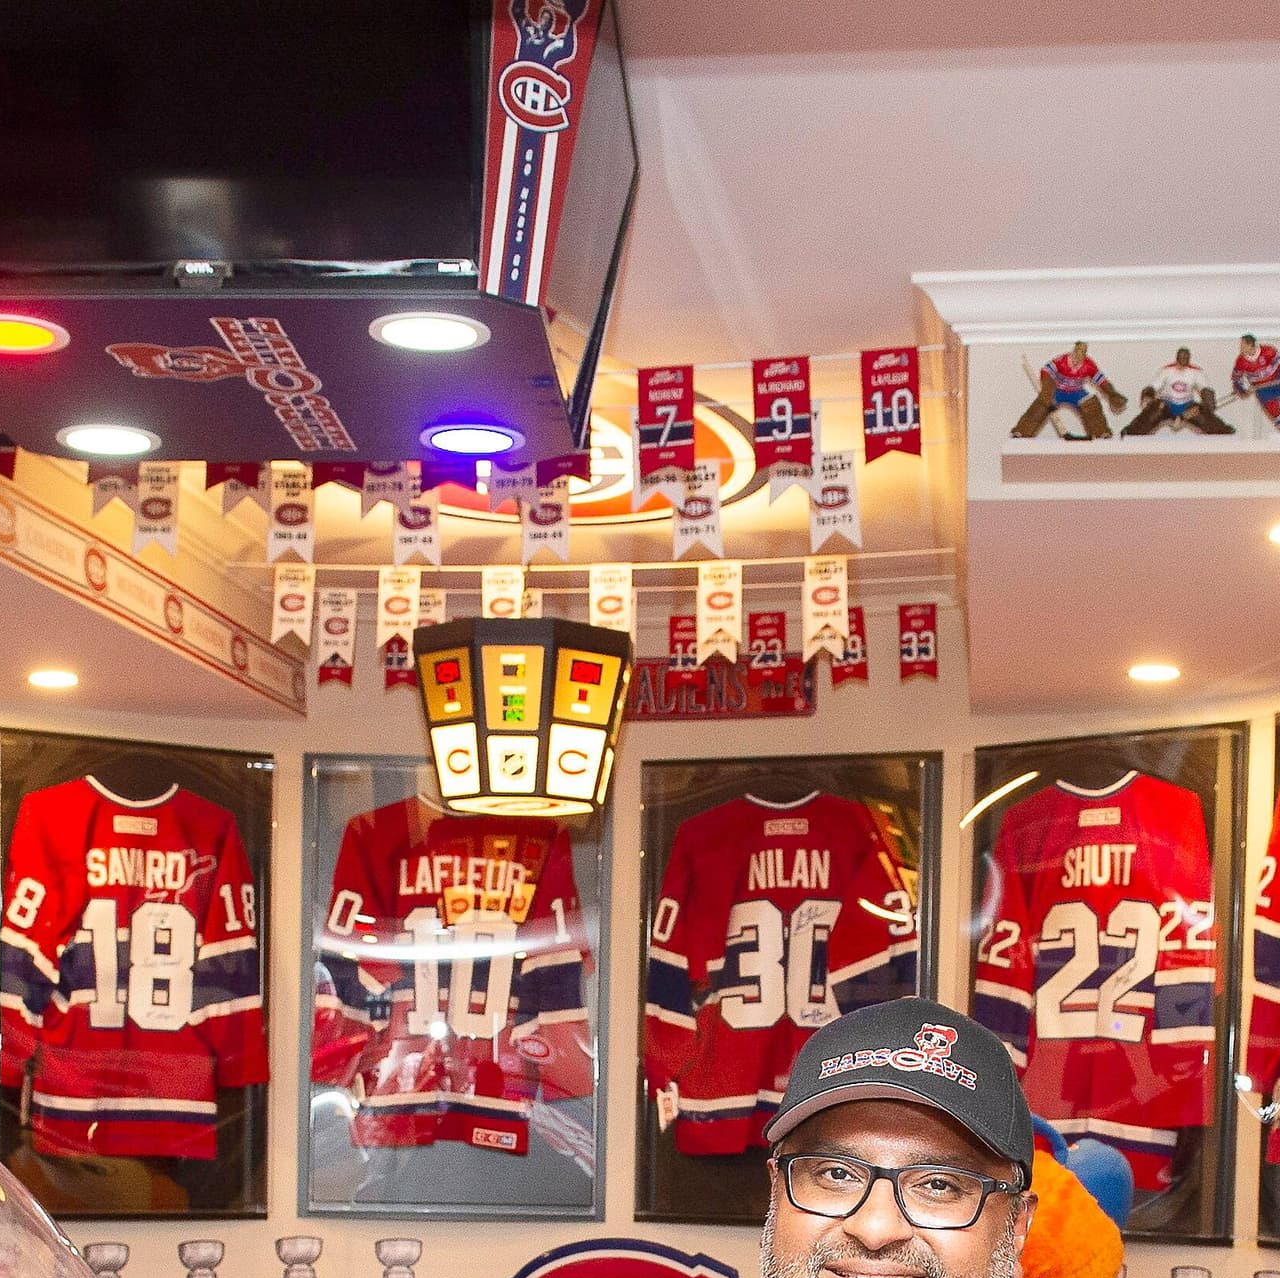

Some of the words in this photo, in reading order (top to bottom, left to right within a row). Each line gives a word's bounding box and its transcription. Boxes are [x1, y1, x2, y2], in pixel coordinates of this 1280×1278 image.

[655, 404, 678, 448] 7
[771, 397, 793, 441] 9
[871, 387, 914, 434] 10
[900, 631, 937, 663] 33
[86, 849, 186, 890] SAVARD
[398, 857, 524, 896] LAFLEUR
[748, 849, 831, 891] NILAN
[1062, 844, 1137, 888] SHUTT
[83, 897, 197, 1031] 18
[404, 907, 518, 1039] 10
[720, 898, 842, 1030] 30
[1035, 899, 1162, 1041] 22
